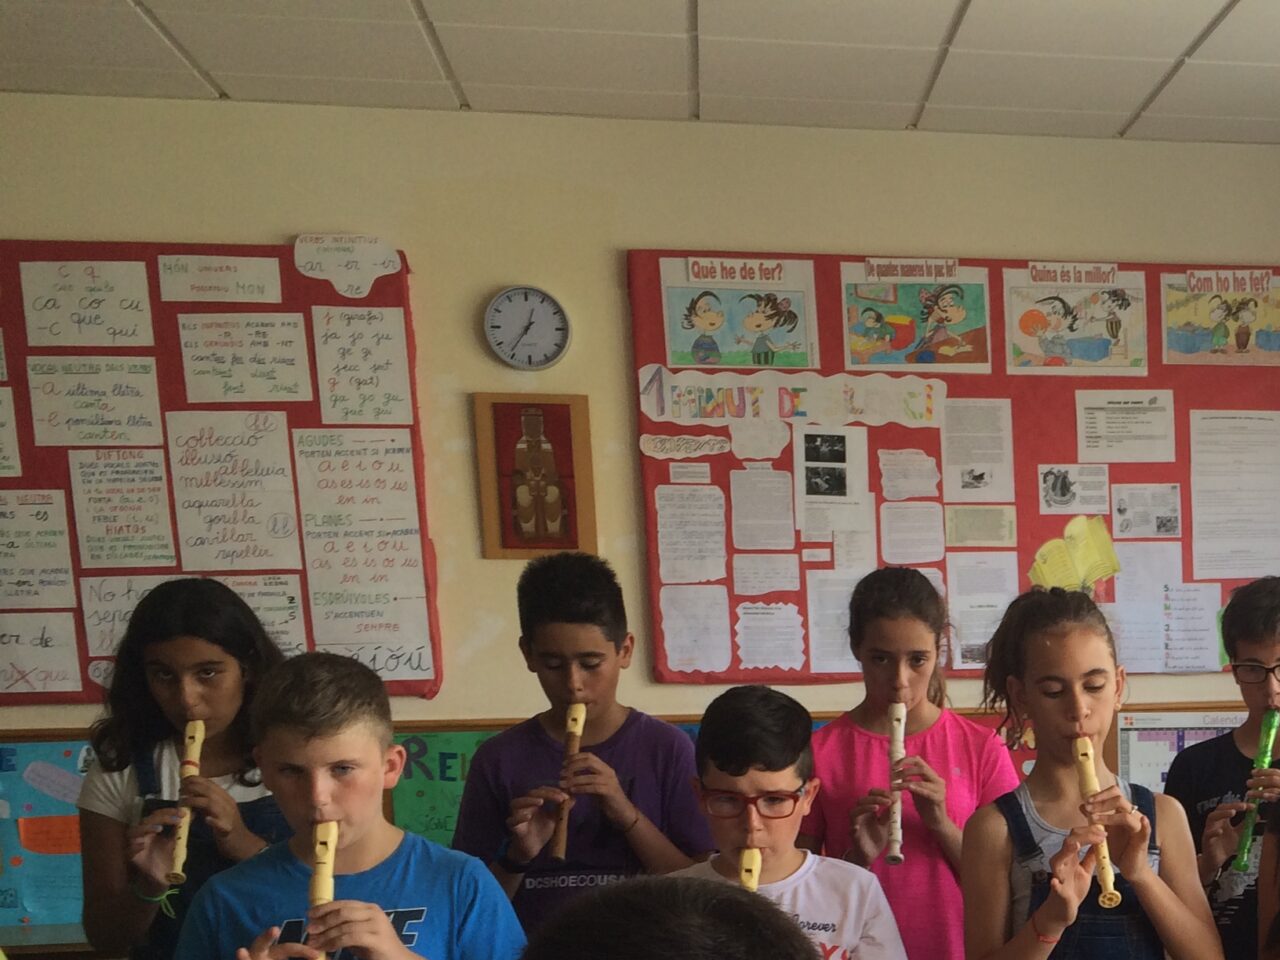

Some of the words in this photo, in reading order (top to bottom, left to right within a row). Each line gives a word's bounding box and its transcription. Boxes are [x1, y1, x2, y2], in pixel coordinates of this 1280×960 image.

[691, 262, 717, 280] Què
[721, 263, 735, 279] he
[740, 264, 755, 280] de
[759, 263, 784, 281] fer?
[1030, 268, 1057, 283] Quina
[1074, 268, 1083, 283] la
[1085, 267, 1116, 284] millor?
[1188, 273, 1213, 292] Com
[1216, 273, 1230, 292] ho
[1233, 273, 1247, 292] he
[1249, 272, 1271, 292] fet?
[640, 365, 666, 418] 1
[778, 387, 807, 418] DE
[297, 434, 345, 447] AGUDES
[96, 450, 145, 461] DIFTONG
[305, 513, 353, 527] PLANES
[88, 579, 116, 602] No
[353, 622, 400, 634] SEMPRE
